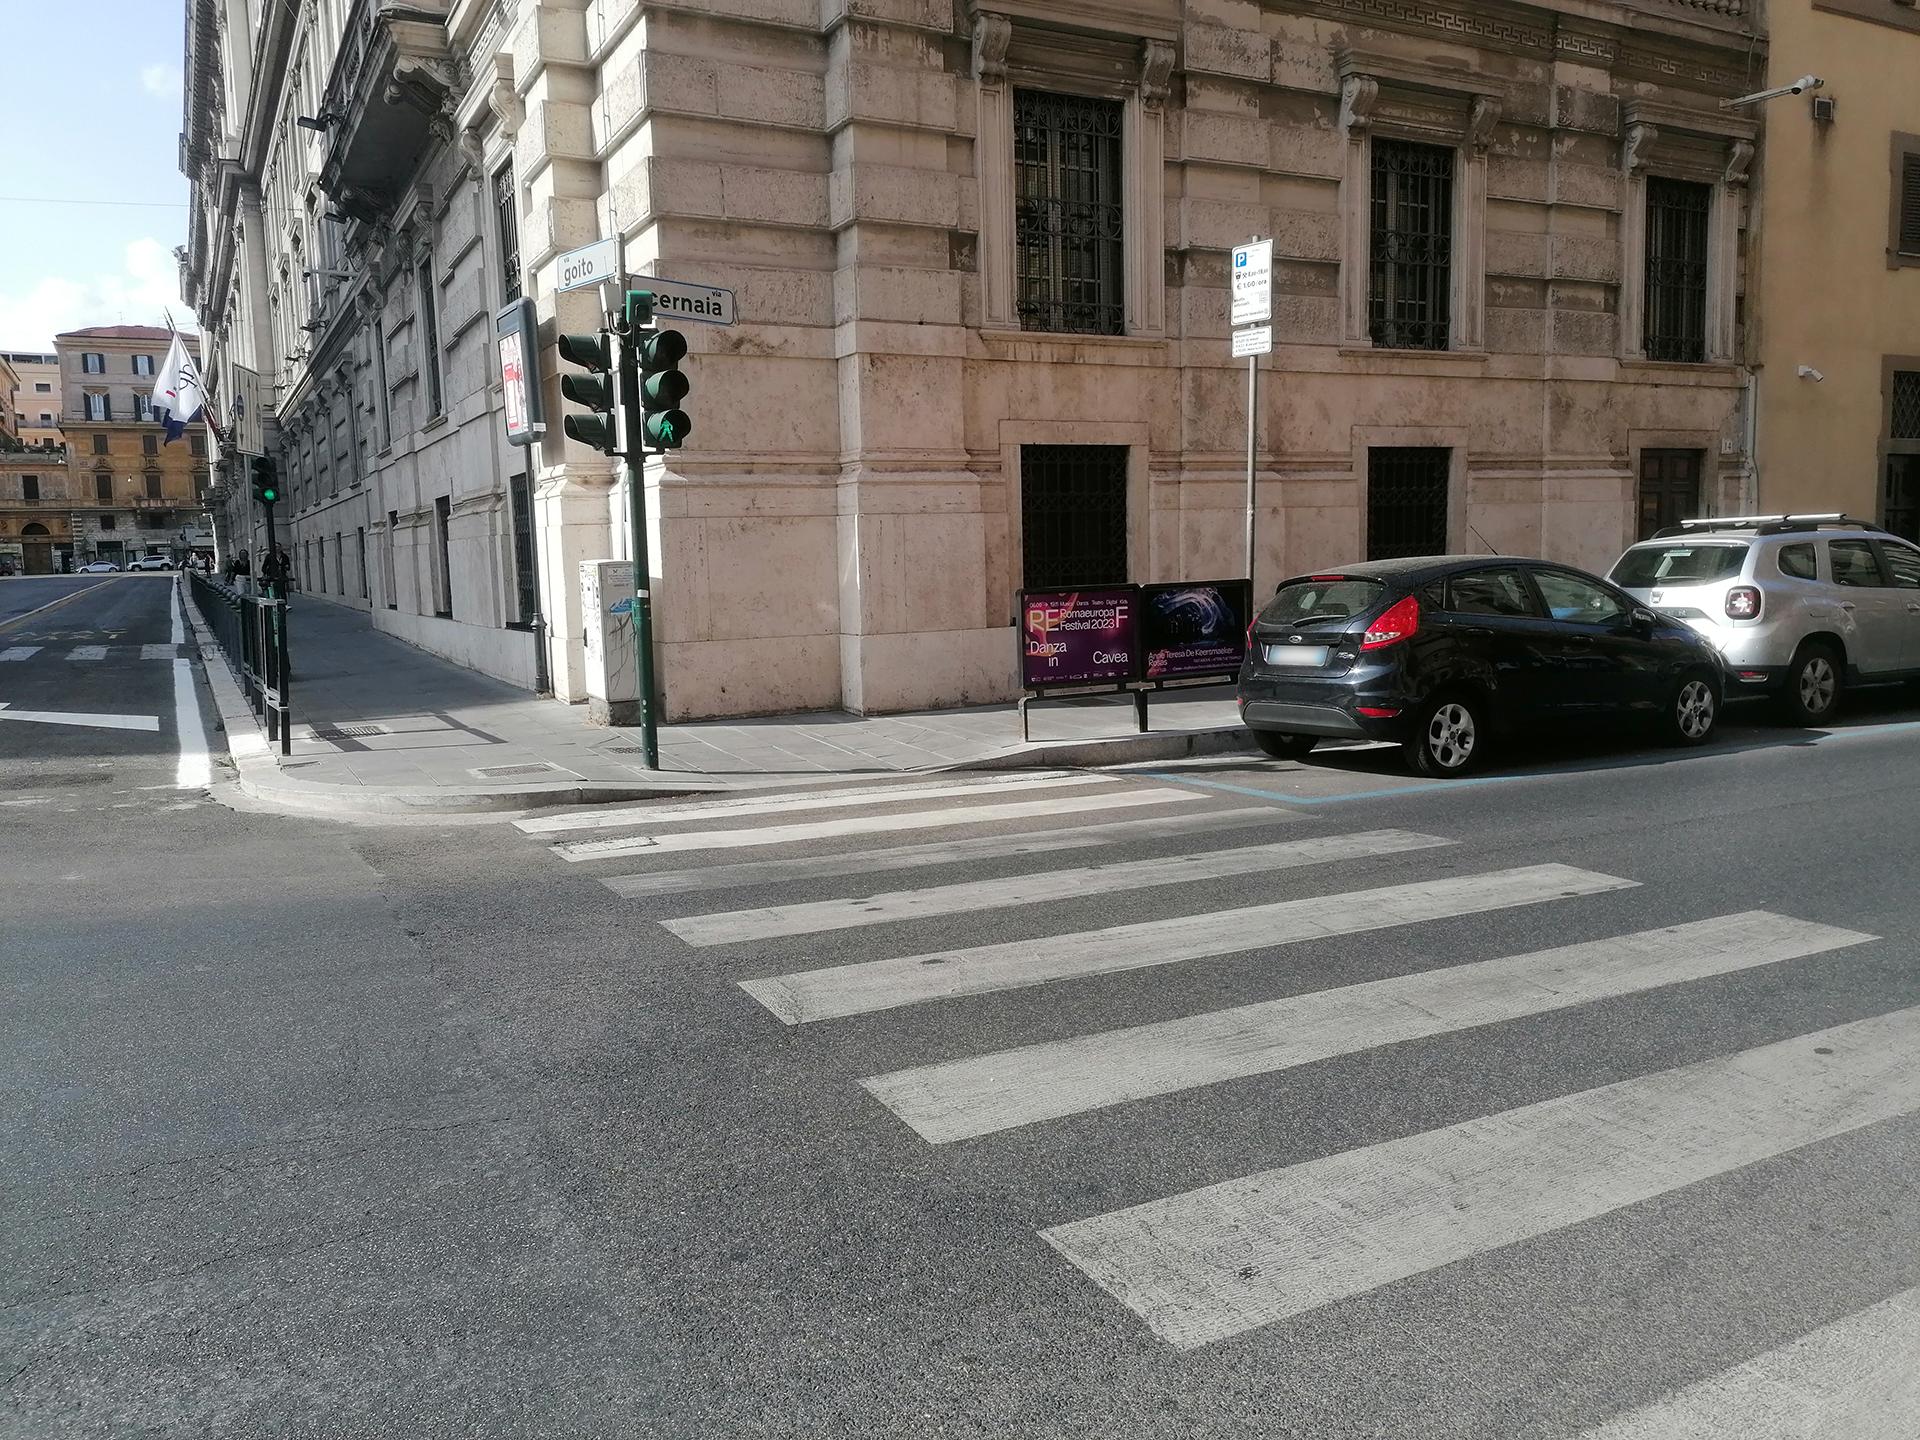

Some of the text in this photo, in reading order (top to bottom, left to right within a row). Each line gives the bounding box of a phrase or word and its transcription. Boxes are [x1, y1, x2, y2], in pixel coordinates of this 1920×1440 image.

[564, 258, 594, 286] goito
[711, 290, 722, 298] via
[652, 292, 723, 317] cernaia
[1060, 608, 1115, 618] Romaeuropa
[1060, 618, 1115, 631] Festival 2023
[1030, 641, 1067, 654] Danza
[1186, 649, 1195, 657] De
[1048, 654, 1059, 667] in
[1092, 650, 1129, 665] Cavea
